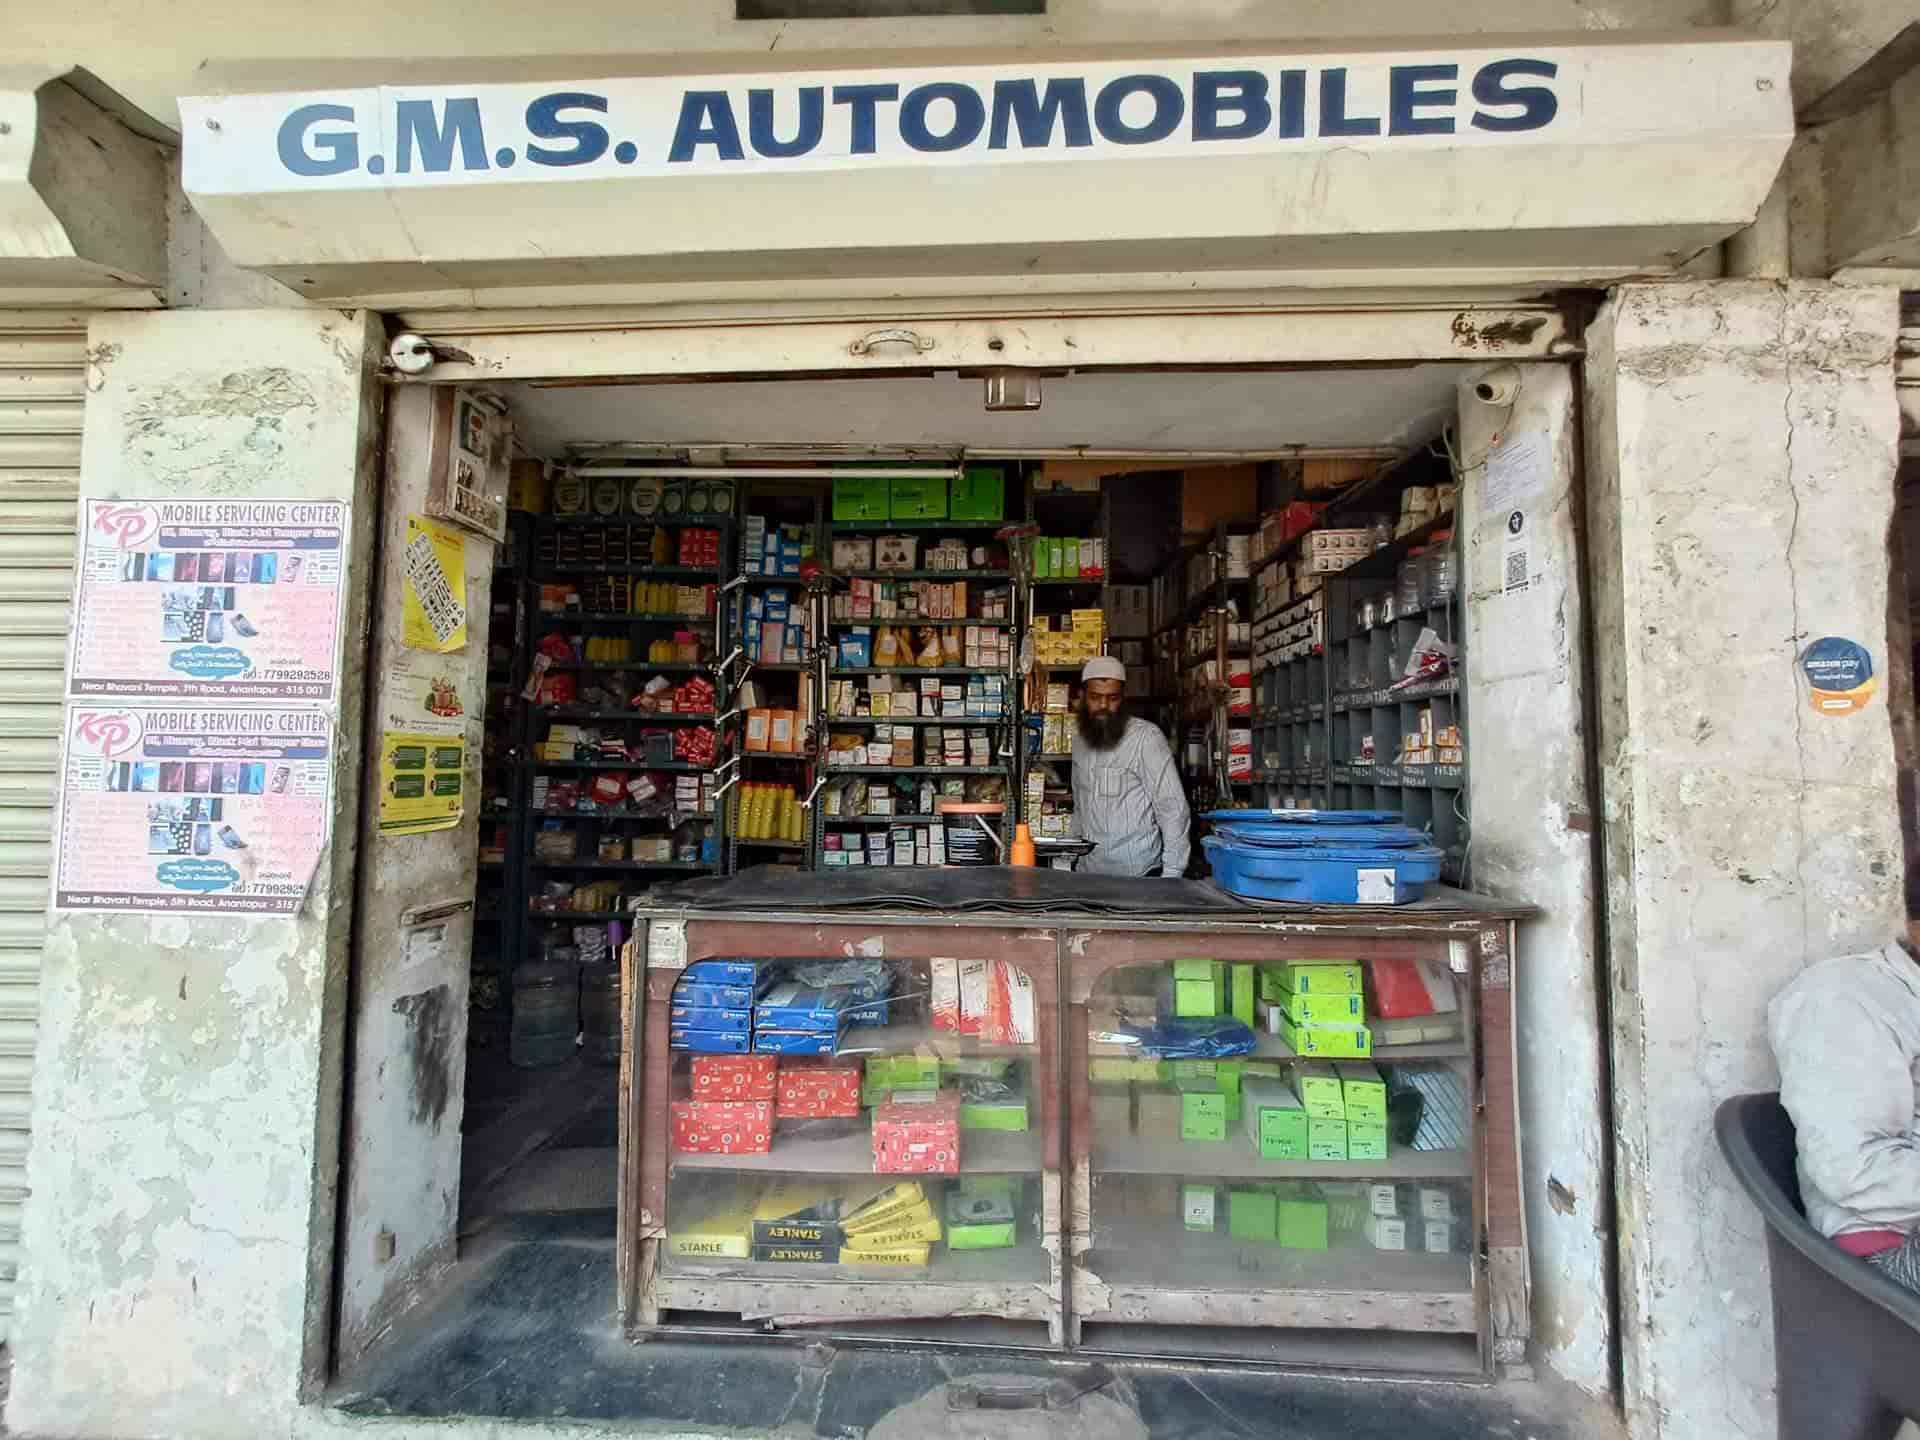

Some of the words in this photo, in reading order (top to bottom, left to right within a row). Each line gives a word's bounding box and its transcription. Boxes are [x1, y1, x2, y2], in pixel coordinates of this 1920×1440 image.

[277, 92, 638, 176] G.M.S.
[667, 58, 1558, 163] AUTOMOBILES
[161, 505, 211, 522] MOBILE
[215, 505, 286, 522] SERVICING
[291, 506, 340, 523] CENTER
[145, 713, 197, 730] MOBILE
[201, 713, 273, 731] SERVICING
[279, 714, 326, 732] CENTER
[67, 895, 91, 904] Near
[768, 1227, 822, 1241] STANLEY
[768, 1248, 823, 1261] STANLEY
[857, 1251, 911, 1264] STANLEY
